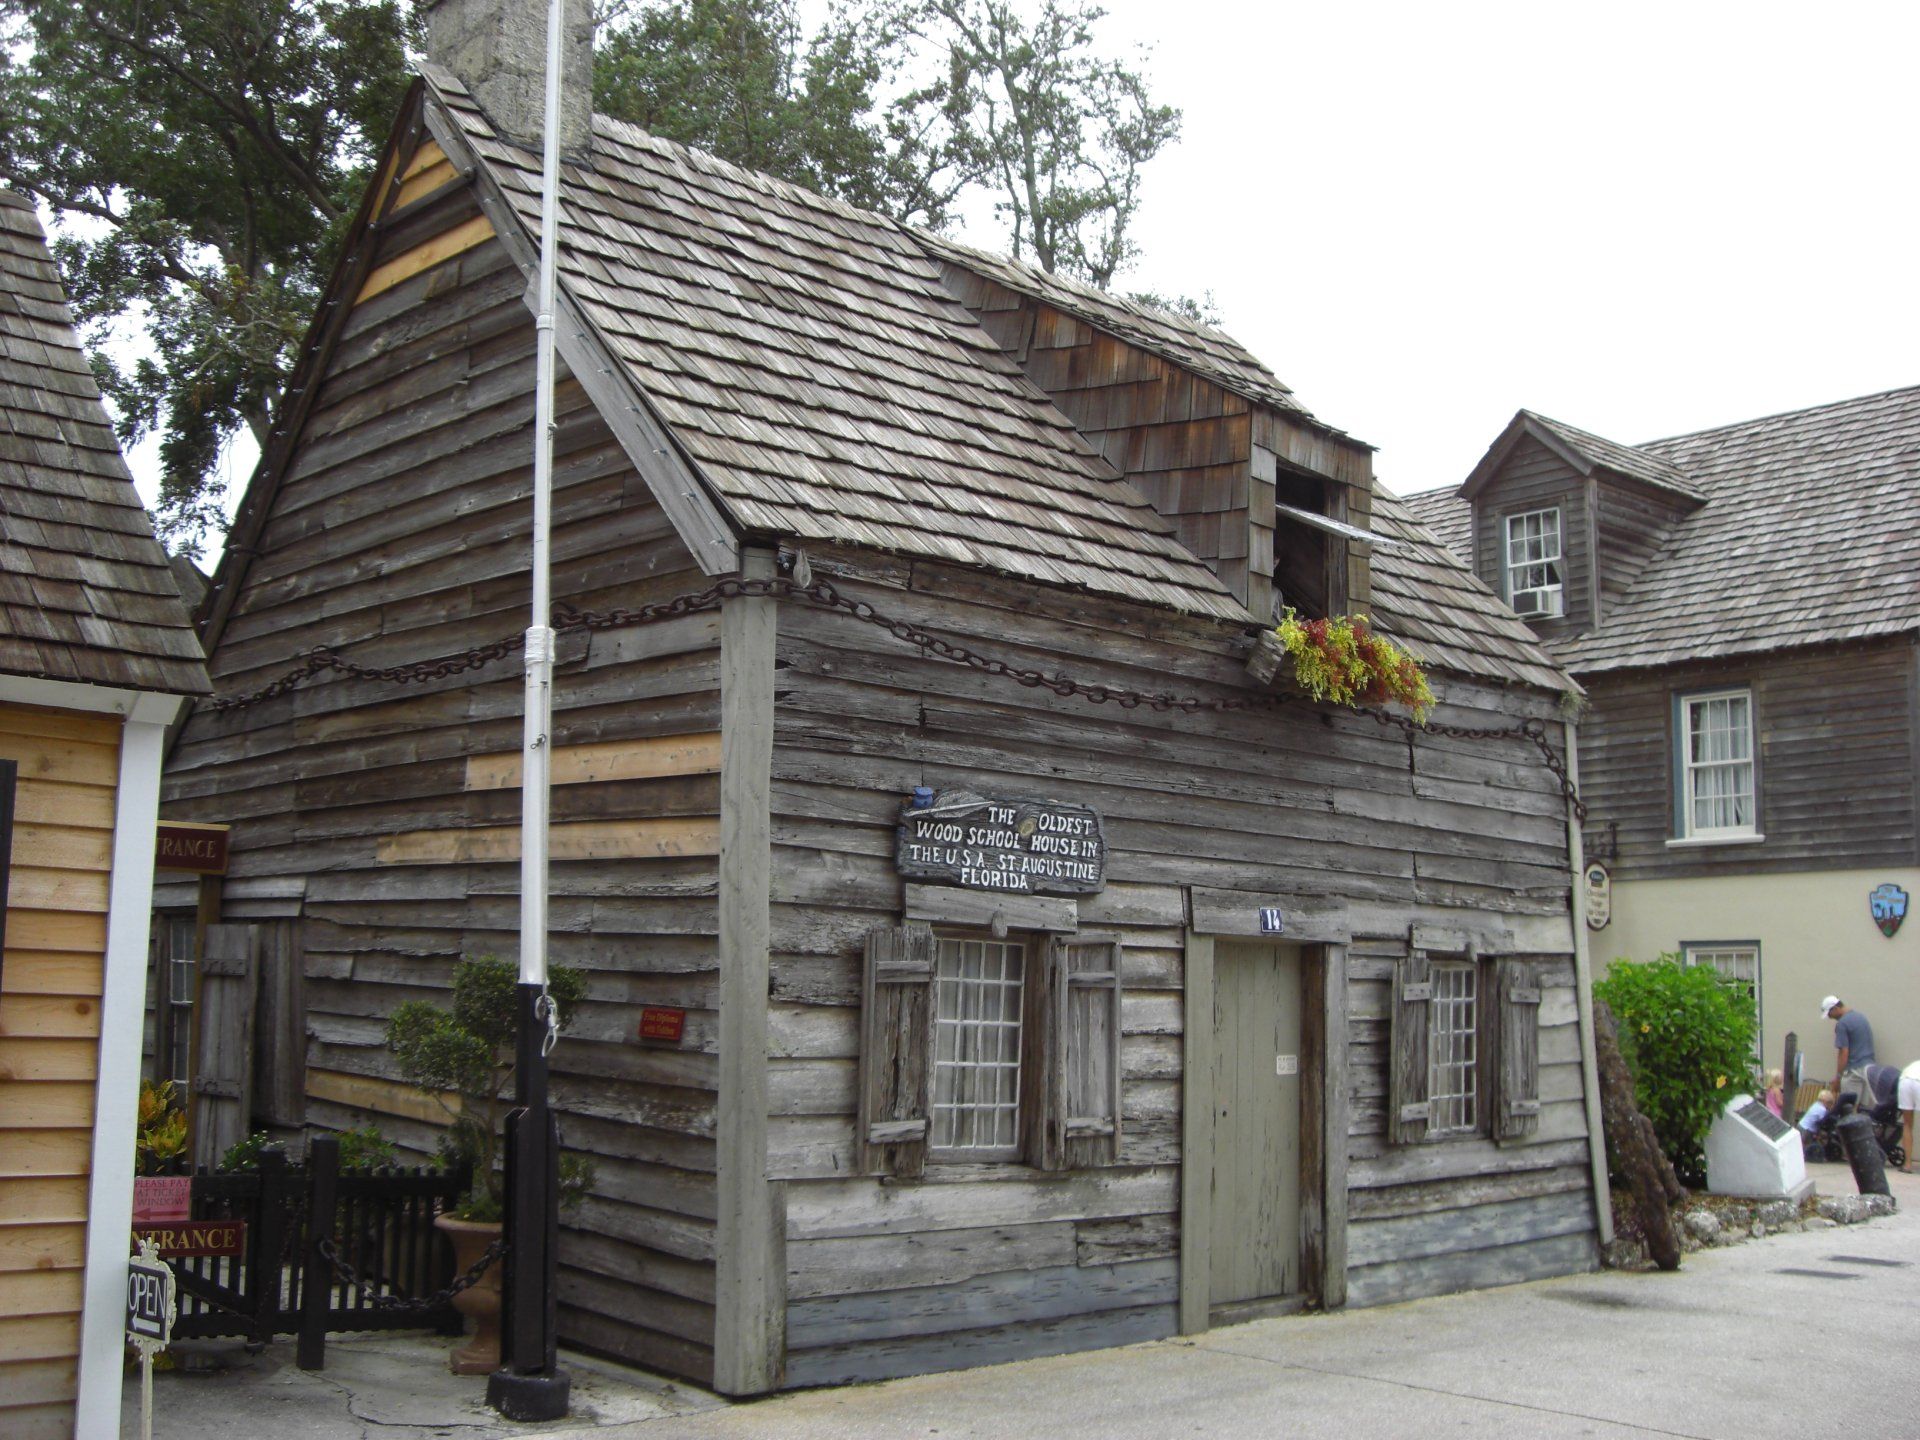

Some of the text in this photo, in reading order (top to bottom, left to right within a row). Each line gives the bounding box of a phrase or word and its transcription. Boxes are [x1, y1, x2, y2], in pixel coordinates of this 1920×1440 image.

[988, 806, 1093, 835] THE OLDEST
[158, 837, 217, 858] RANCE
[916, 820, 1098, 858] WOOD SCHOOL HOUSE IN
[909, 844, 941, 863] THE
[1021, 856, 1096, 880] AUGUSTINE
[960, 867, 1029, 890] FLORIDA
[1266, 909, 1280, 930] 14
[135, 1178, 189, 1188] PLEASE PAY
[137, 1188, 186, 1197] AT TICKET
[137, 1197, 185, 1207] WINDOW
[132, 1228, 236, 1250] NTRANCE
[128, 1272, 167, 1319] OPEN
